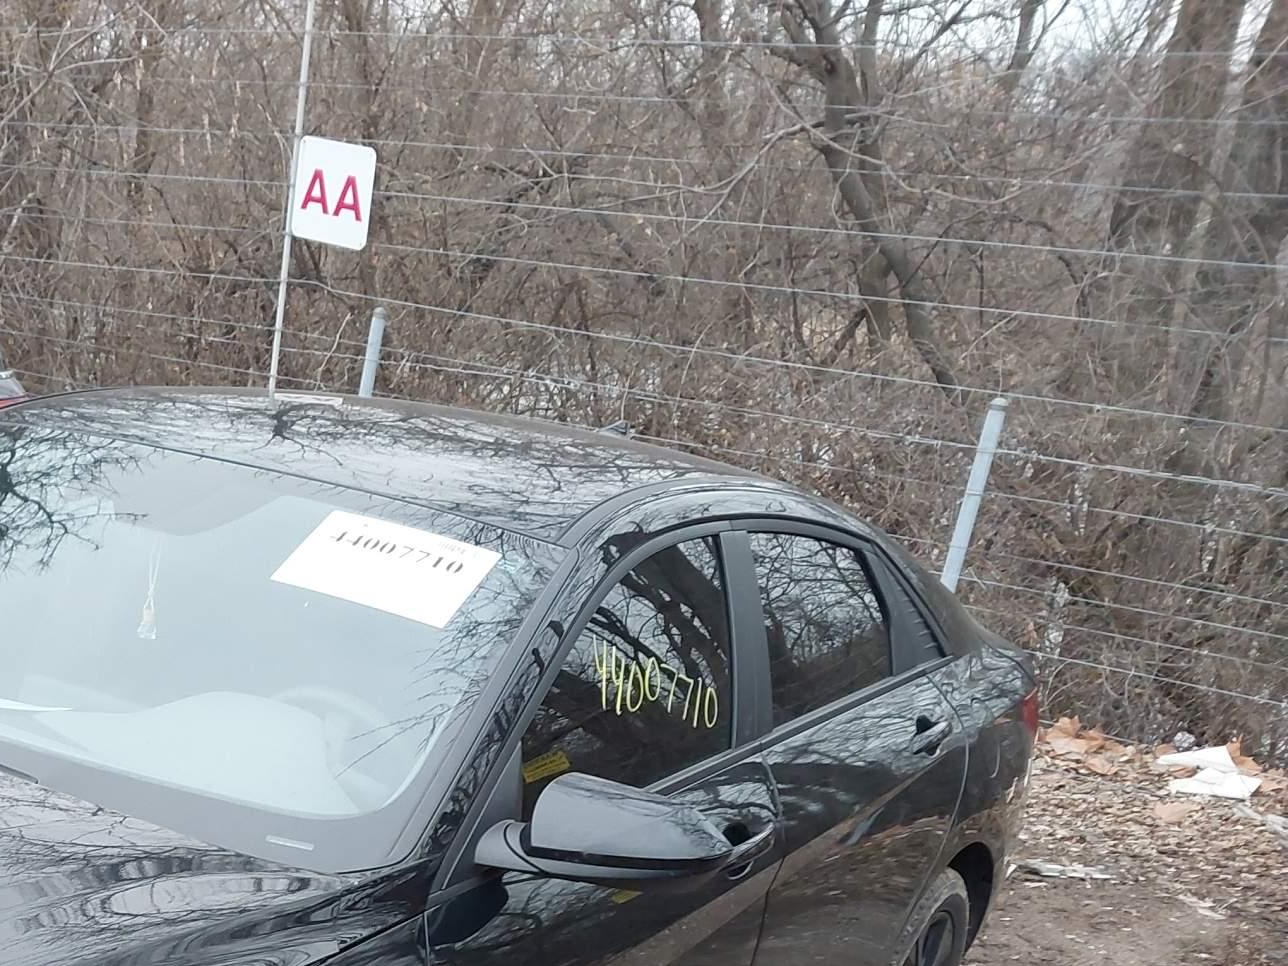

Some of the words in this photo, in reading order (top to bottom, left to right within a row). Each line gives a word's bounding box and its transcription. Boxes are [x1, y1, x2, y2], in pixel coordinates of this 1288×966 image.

[300, 168, 362, 222] AA
[329, 530, 464, 574] 44007710
[593, 634, 719, 728] 44007710
